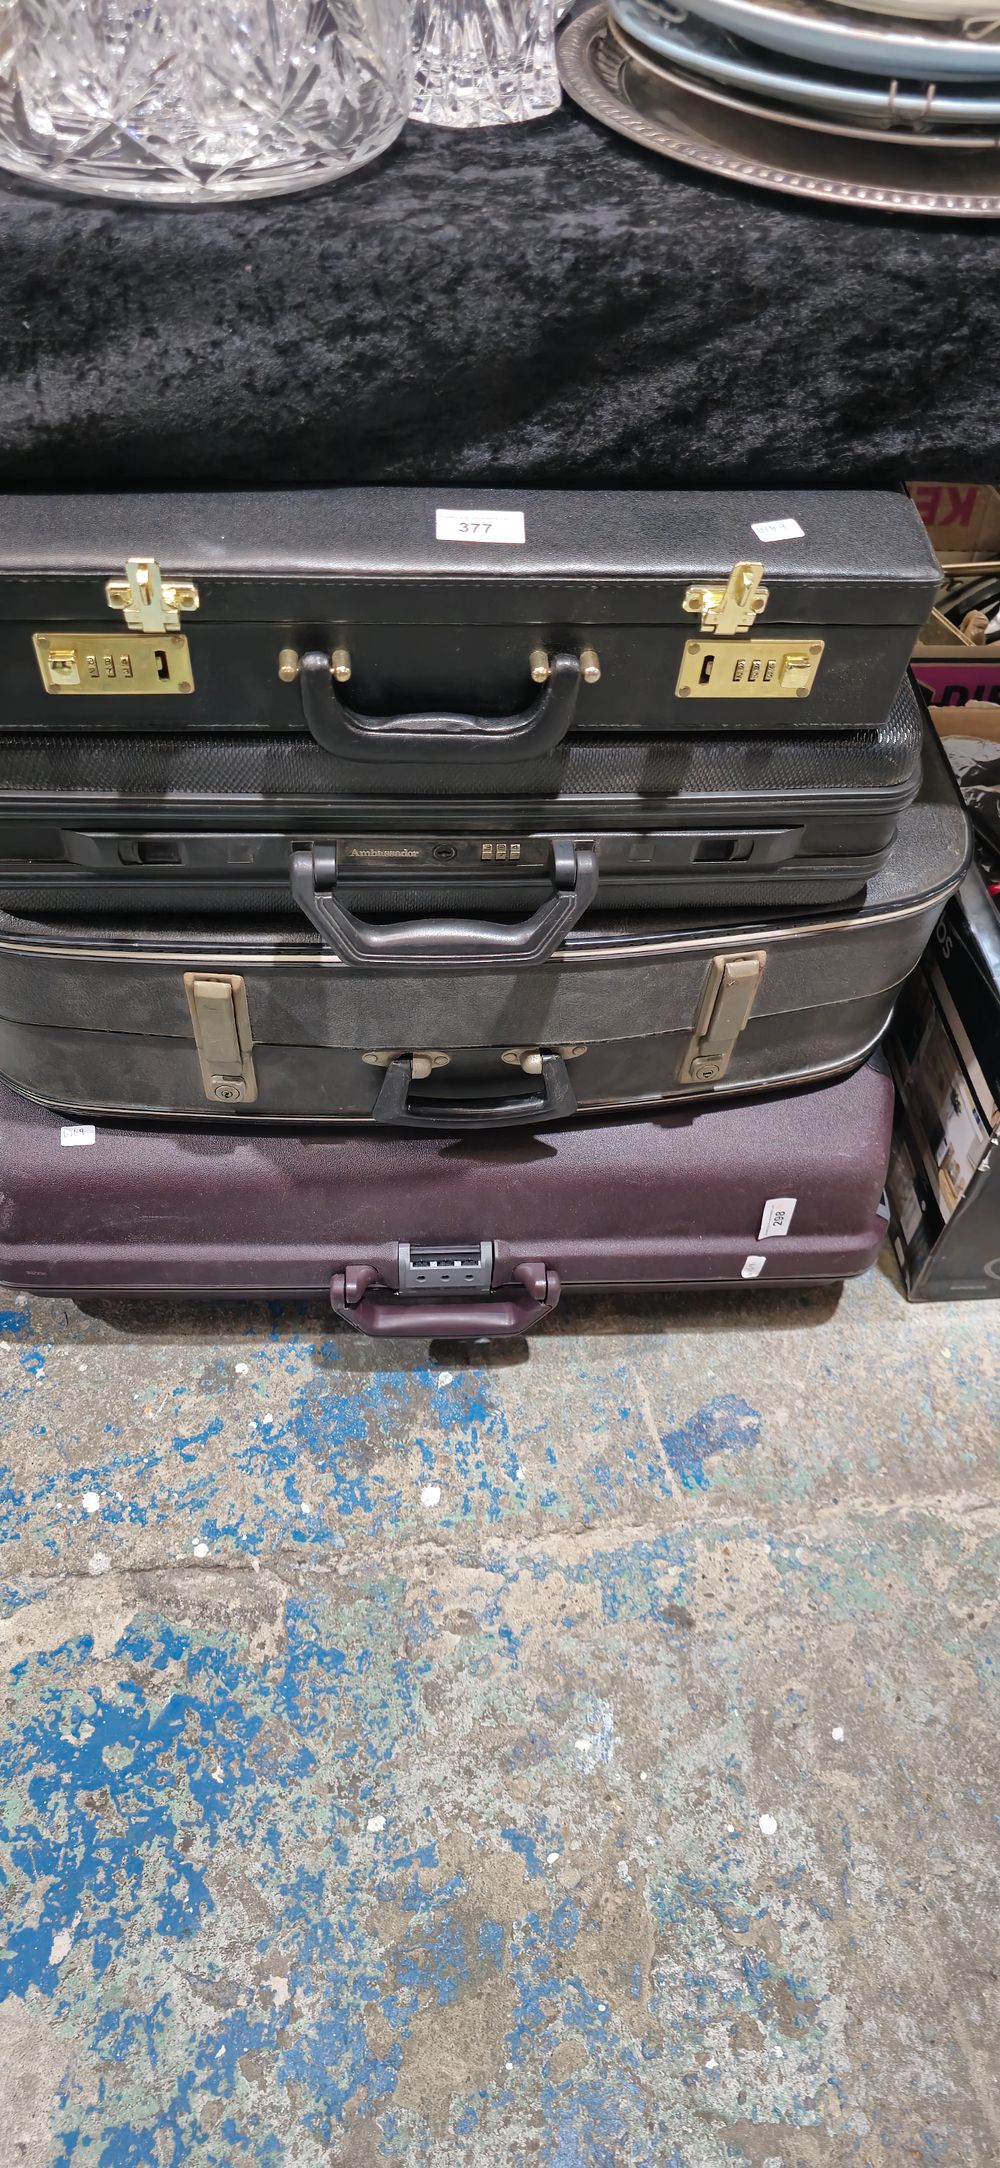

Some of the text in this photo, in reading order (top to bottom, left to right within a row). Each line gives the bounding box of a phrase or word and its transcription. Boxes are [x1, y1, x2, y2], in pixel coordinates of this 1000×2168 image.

[459, 522, 493, 534] 377
[350, 848, 420, 858] Ambassador
[772, 1210, 786, 1227] 298
